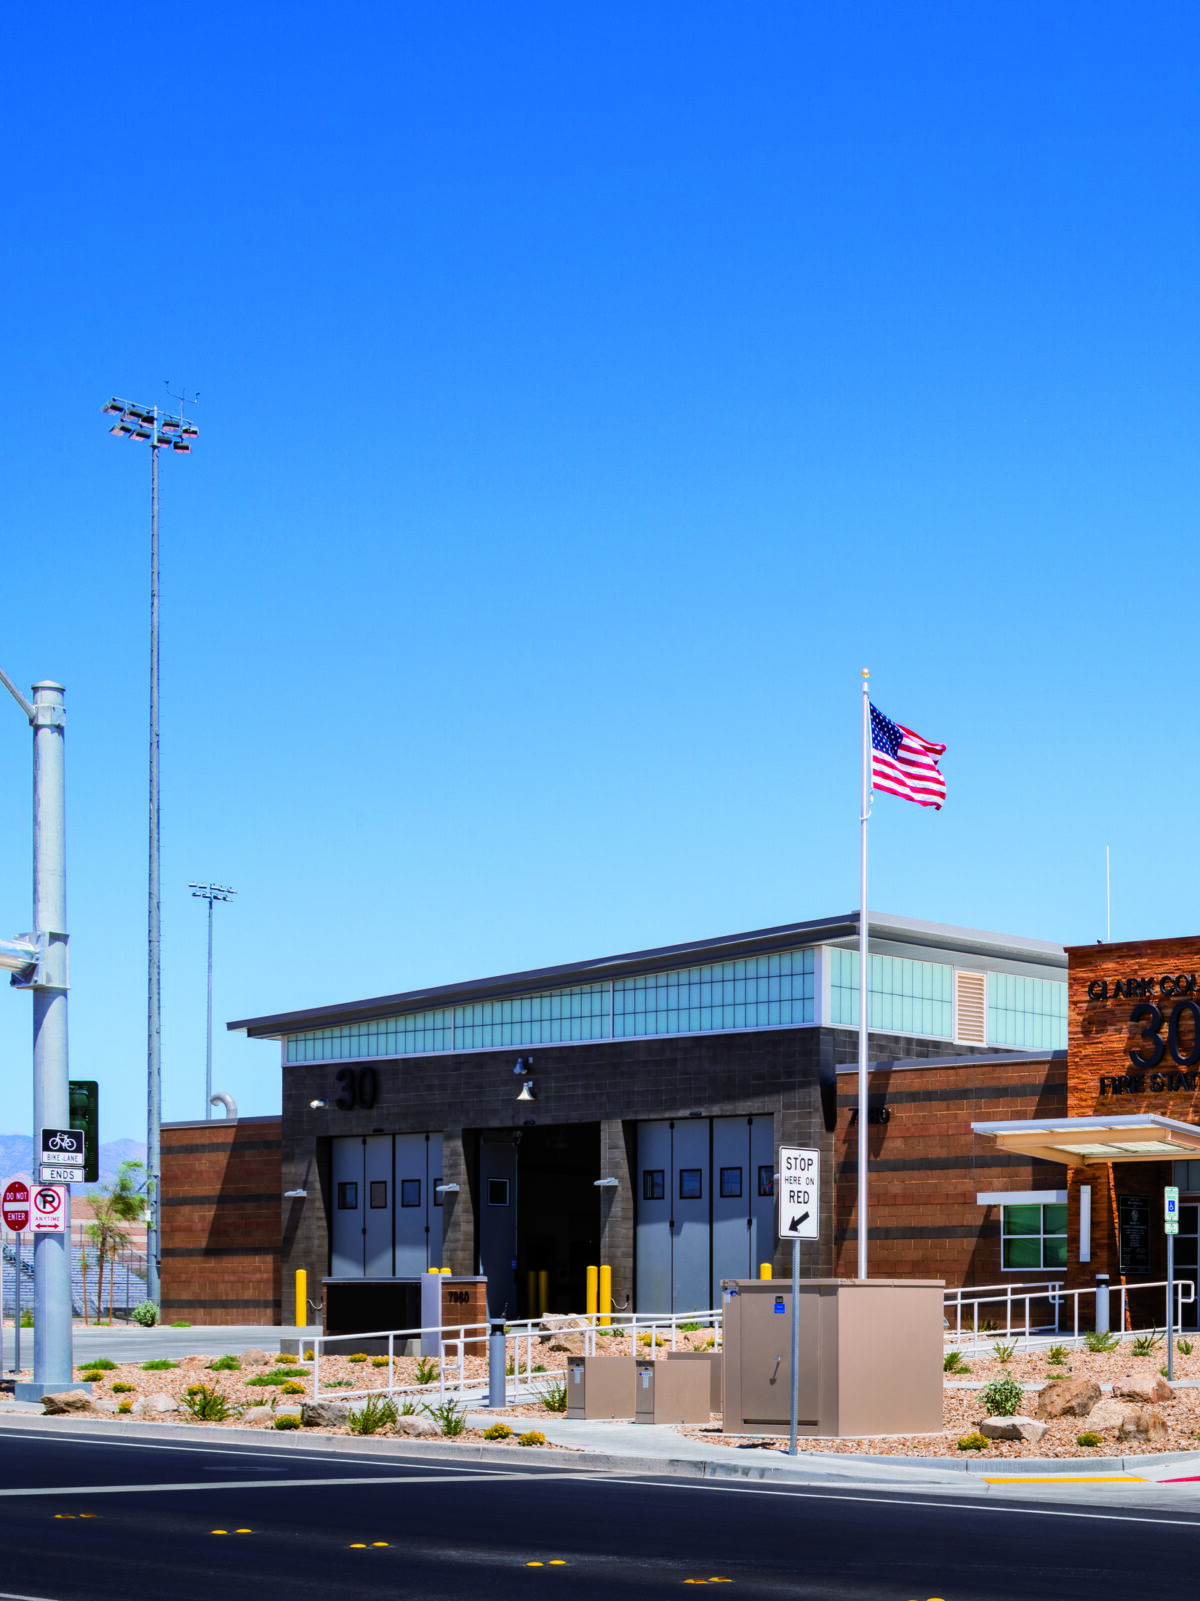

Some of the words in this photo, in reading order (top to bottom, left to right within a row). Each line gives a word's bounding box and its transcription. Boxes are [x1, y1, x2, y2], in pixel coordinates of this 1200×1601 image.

[1087, 976, 1155, 1000] CLARK
[335, 1065, 377, 1110] 30
[1099, 1074, 1146, 1096] FIRE
[848, 1105, 890, 1126] 780
[47, 1153, 60, 1161] BIKE
[63, 1154, 79, 1162] LANE
[785, 1156, 814, 1171] STOP
[50, 1169, 75, 1180] ENDS
[784, 1175, 801, 1185] HERE
[805, 1176, 815, 1186] ON
[6, 1192, 14, 1200] DO
[16, 1192, 27, 1200] NOT
[788, 1189, 810, 1205] RED
[8, 1212, 25, 1221] ENTER
